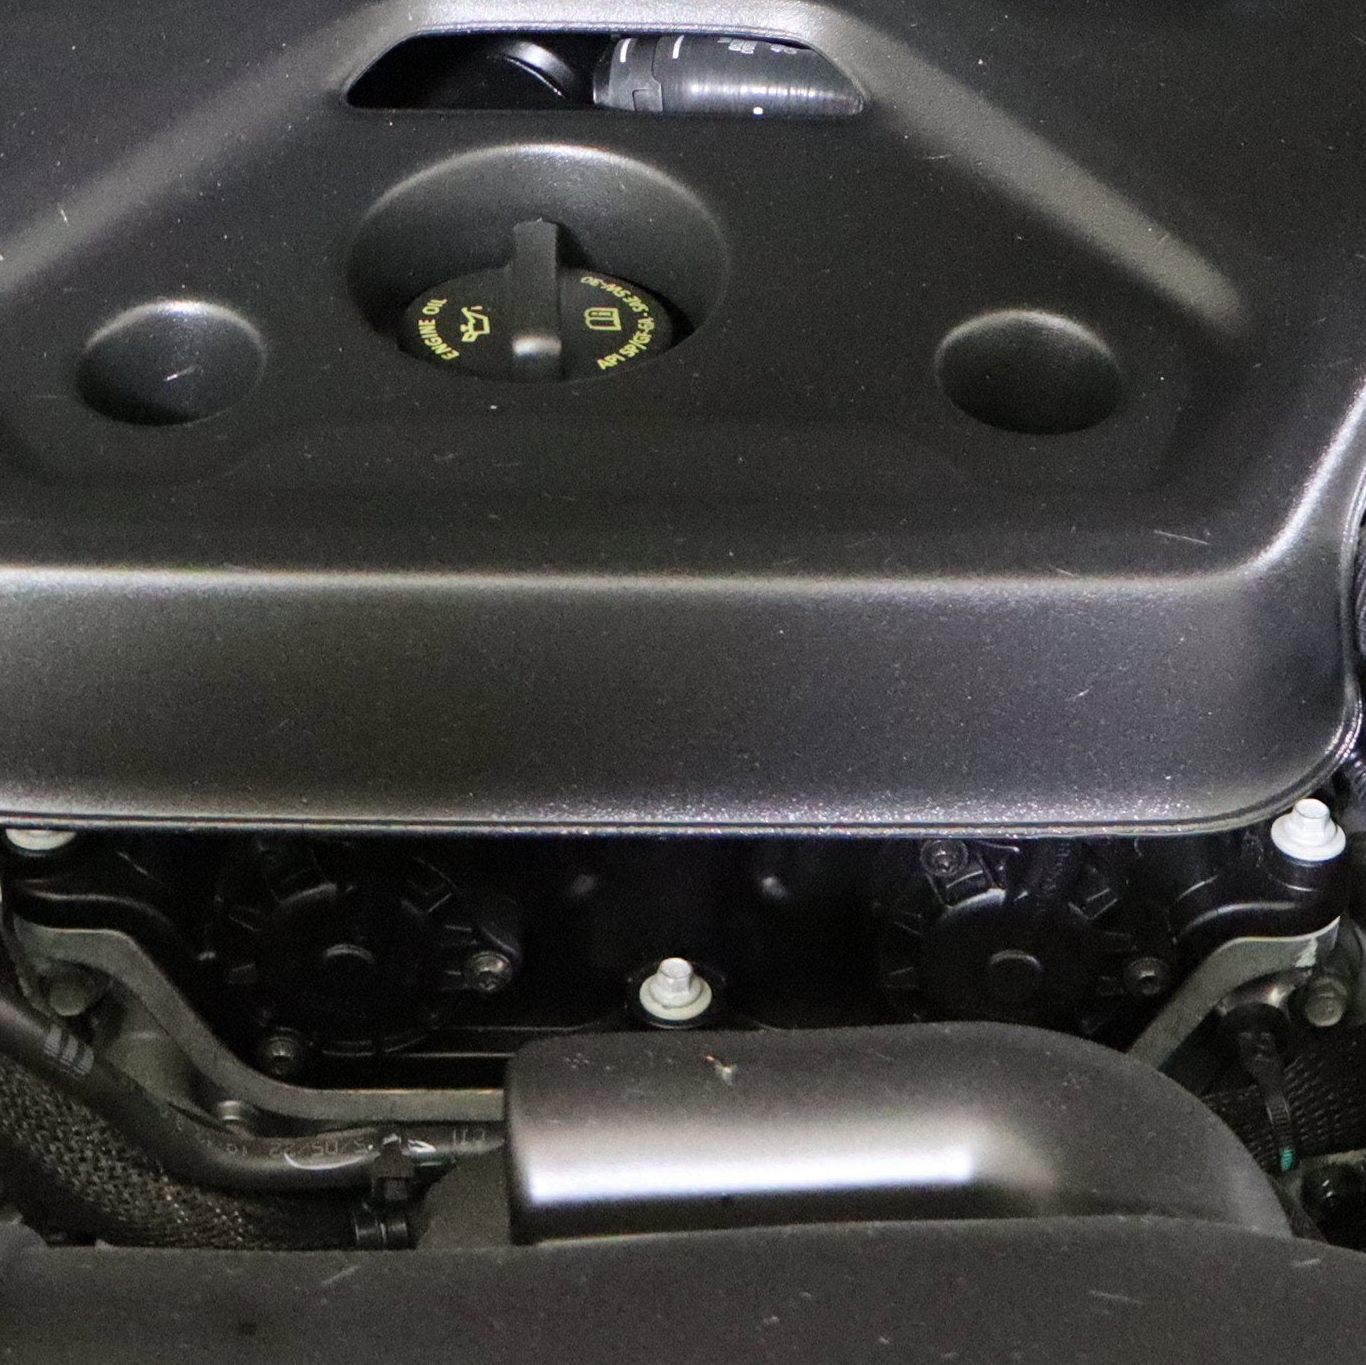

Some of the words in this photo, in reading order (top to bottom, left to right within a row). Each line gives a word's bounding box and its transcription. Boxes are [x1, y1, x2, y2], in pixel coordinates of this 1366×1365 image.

[422, 298, 448, 315] OIL
[622, 296, 649, 312] SAE
[418, 320, 460, 360] ENGINE
[597, 353, 626, 370] API
